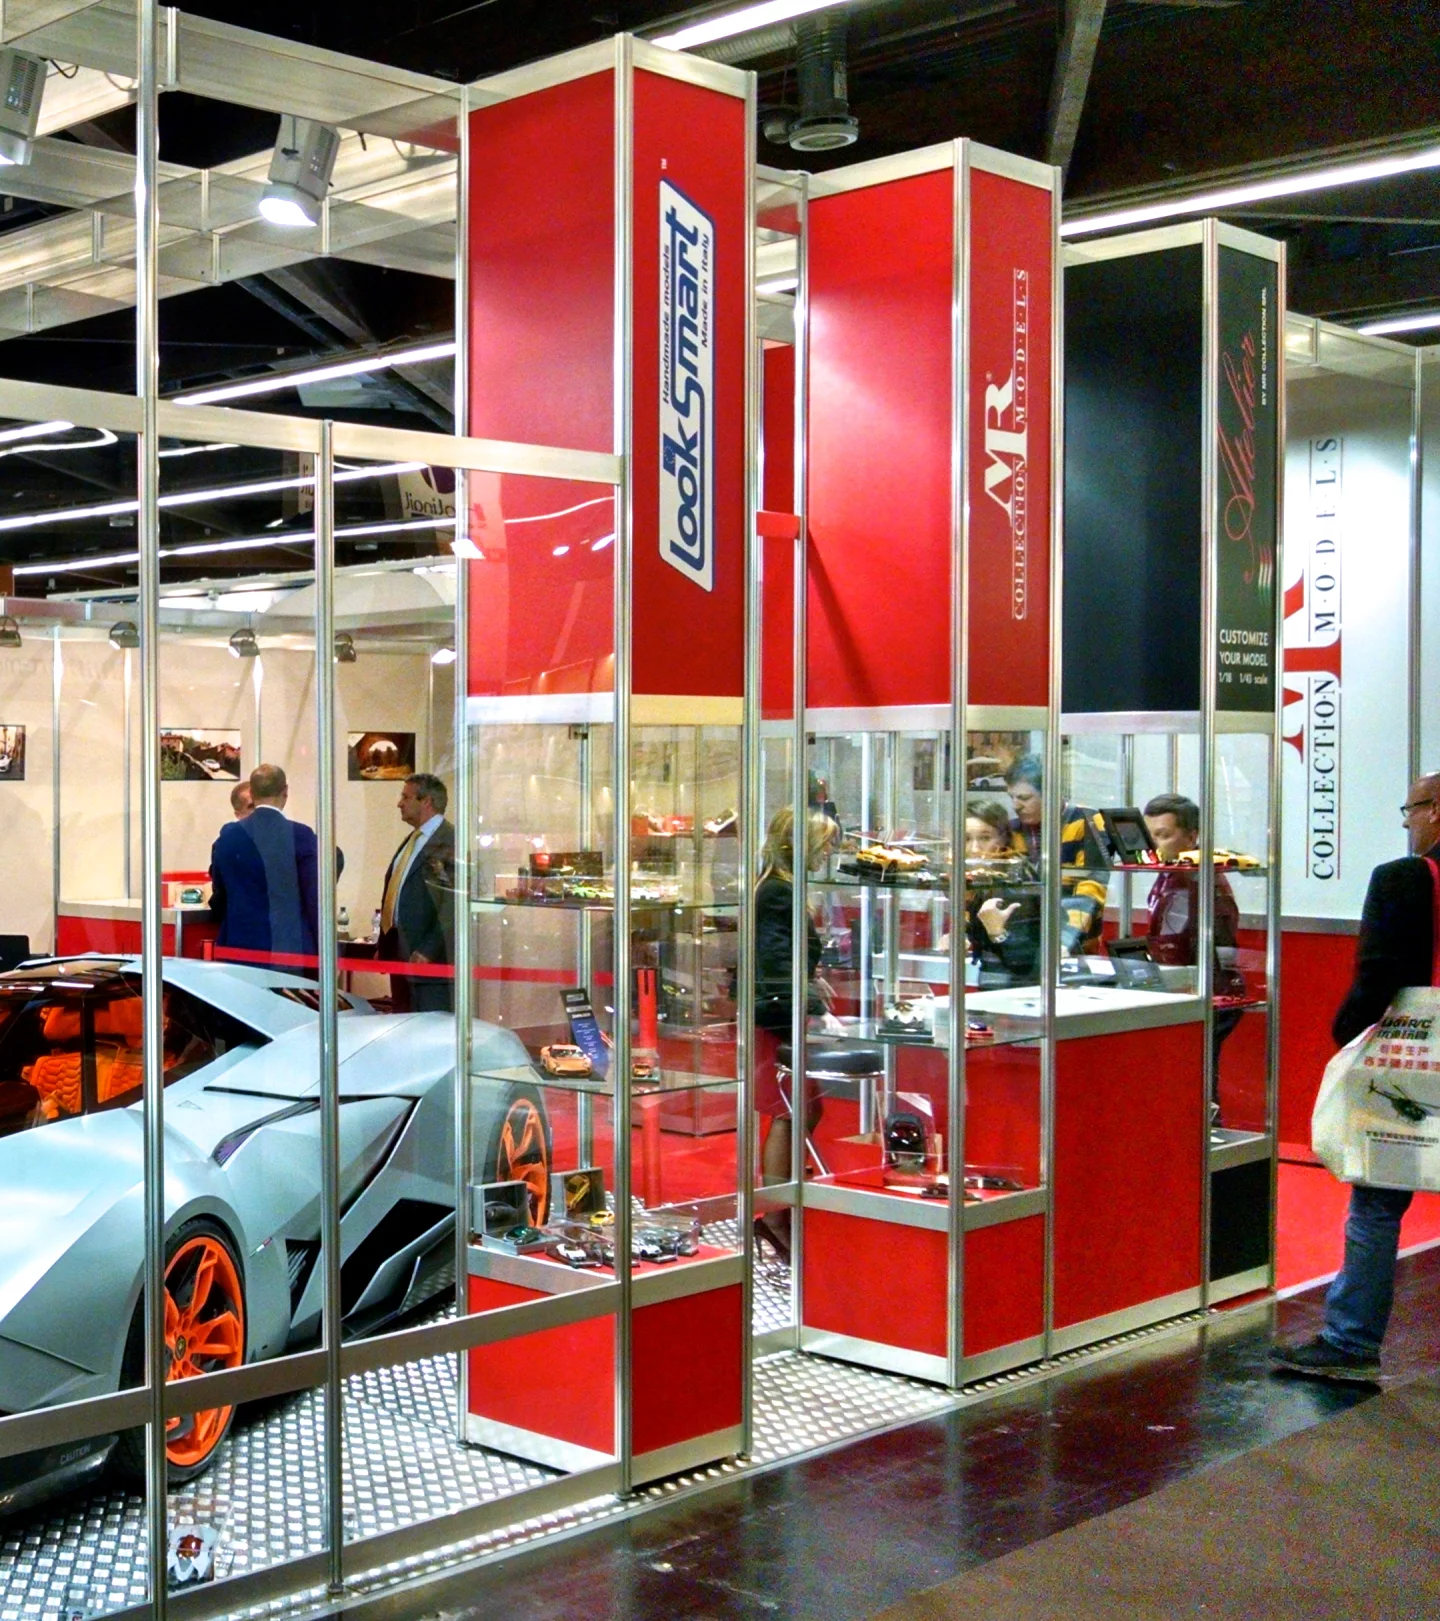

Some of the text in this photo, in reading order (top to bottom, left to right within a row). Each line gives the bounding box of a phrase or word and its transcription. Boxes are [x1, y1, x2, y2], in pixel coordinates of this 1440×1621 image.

[700, 233, 710, 348] Made in Italy
[662, 244, 670, 404] Handmade models
[1261, 380, 1267, 393] MR
[1261, 394, 1267, 406] BY
[984, 369, 1028, 527] MR
[1219, 629, 1269, 646] CUSTOMIZE
[1219, 651, 1269, 667] YOUR MODEL
